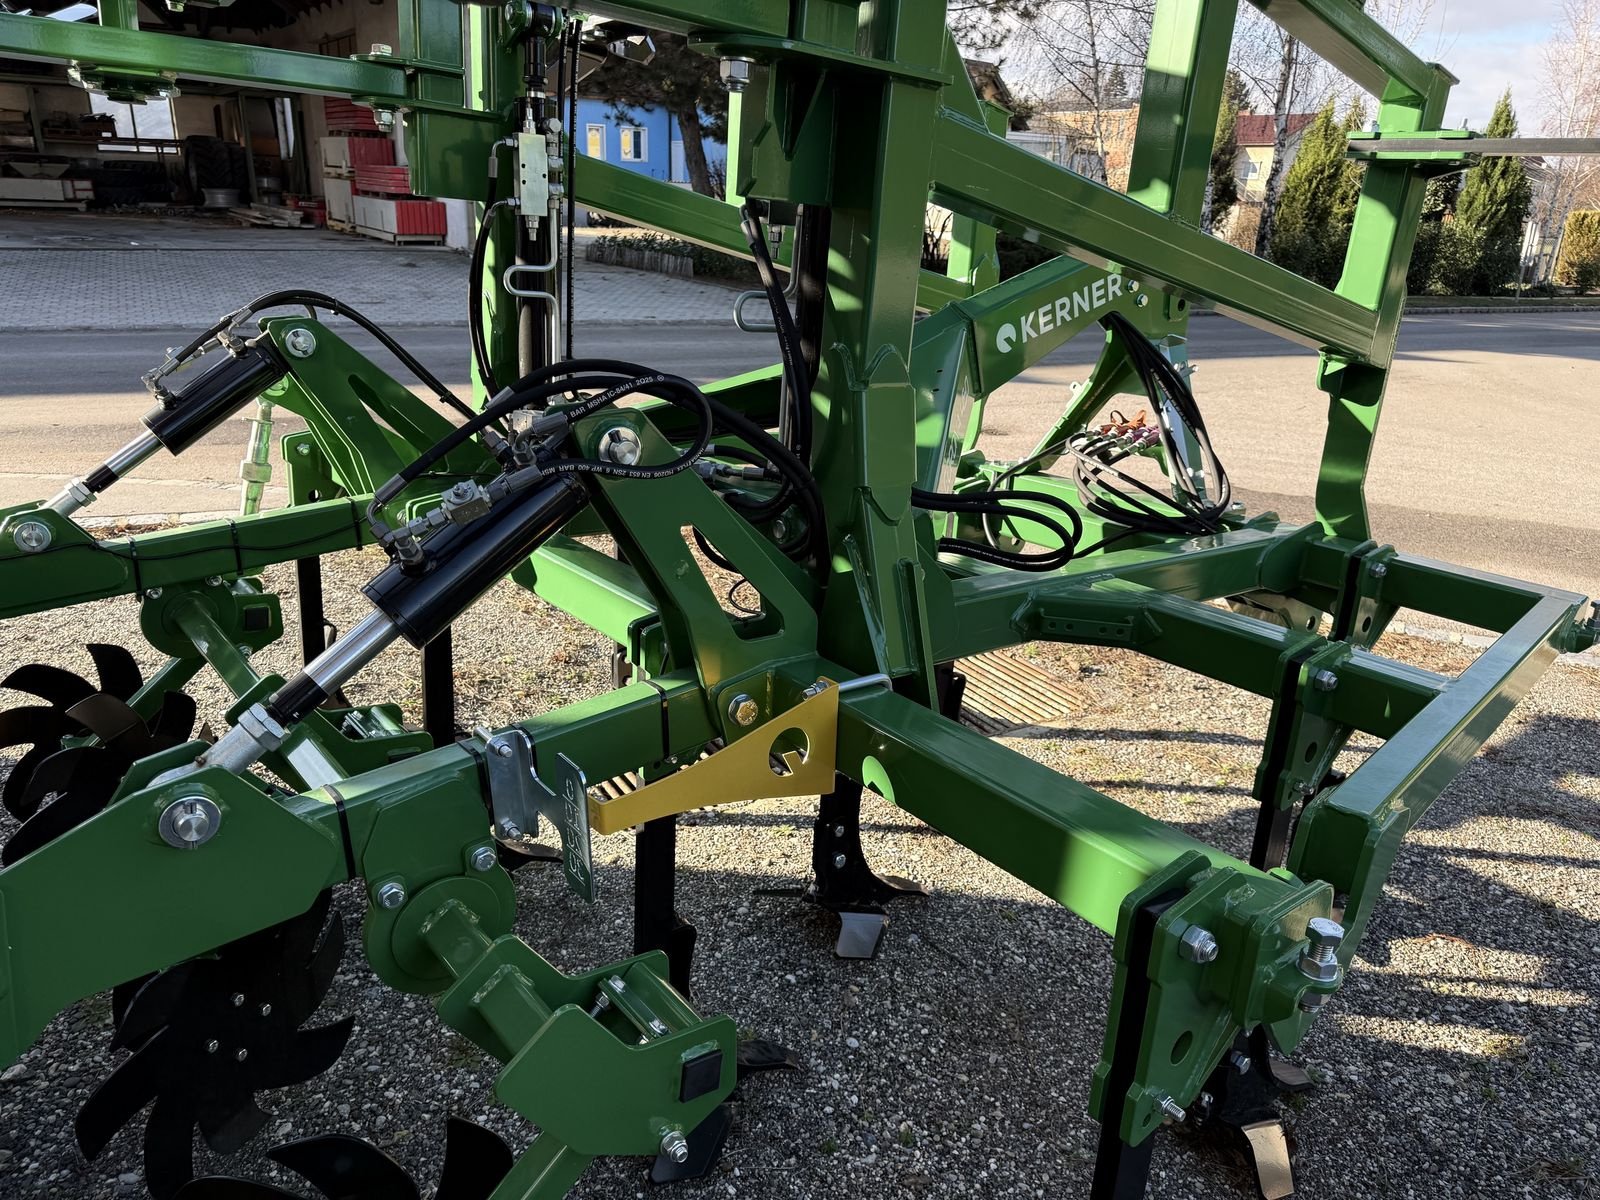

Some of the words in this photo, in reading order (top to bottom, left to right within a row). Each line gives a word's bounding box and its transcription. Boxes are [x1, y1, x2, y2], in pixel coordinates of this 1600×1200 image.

[1020, 273, 1123, 343] KERNER
[570, 406, 586, 418] BAR
[587, 395, 607, 410] MSHA
[607, 382, 633, 398] IC-84/41
[635, 376, 654, 386] 2Q25
[541, 467, 556, 477] MSH
[558, 463, 575, 473] BAR
[577, 464, 591, 472] 400
[591, 465, 604, 473] WP
[612, 468, 627, 477] 2SN
[641, 471, 651, 479] EN
